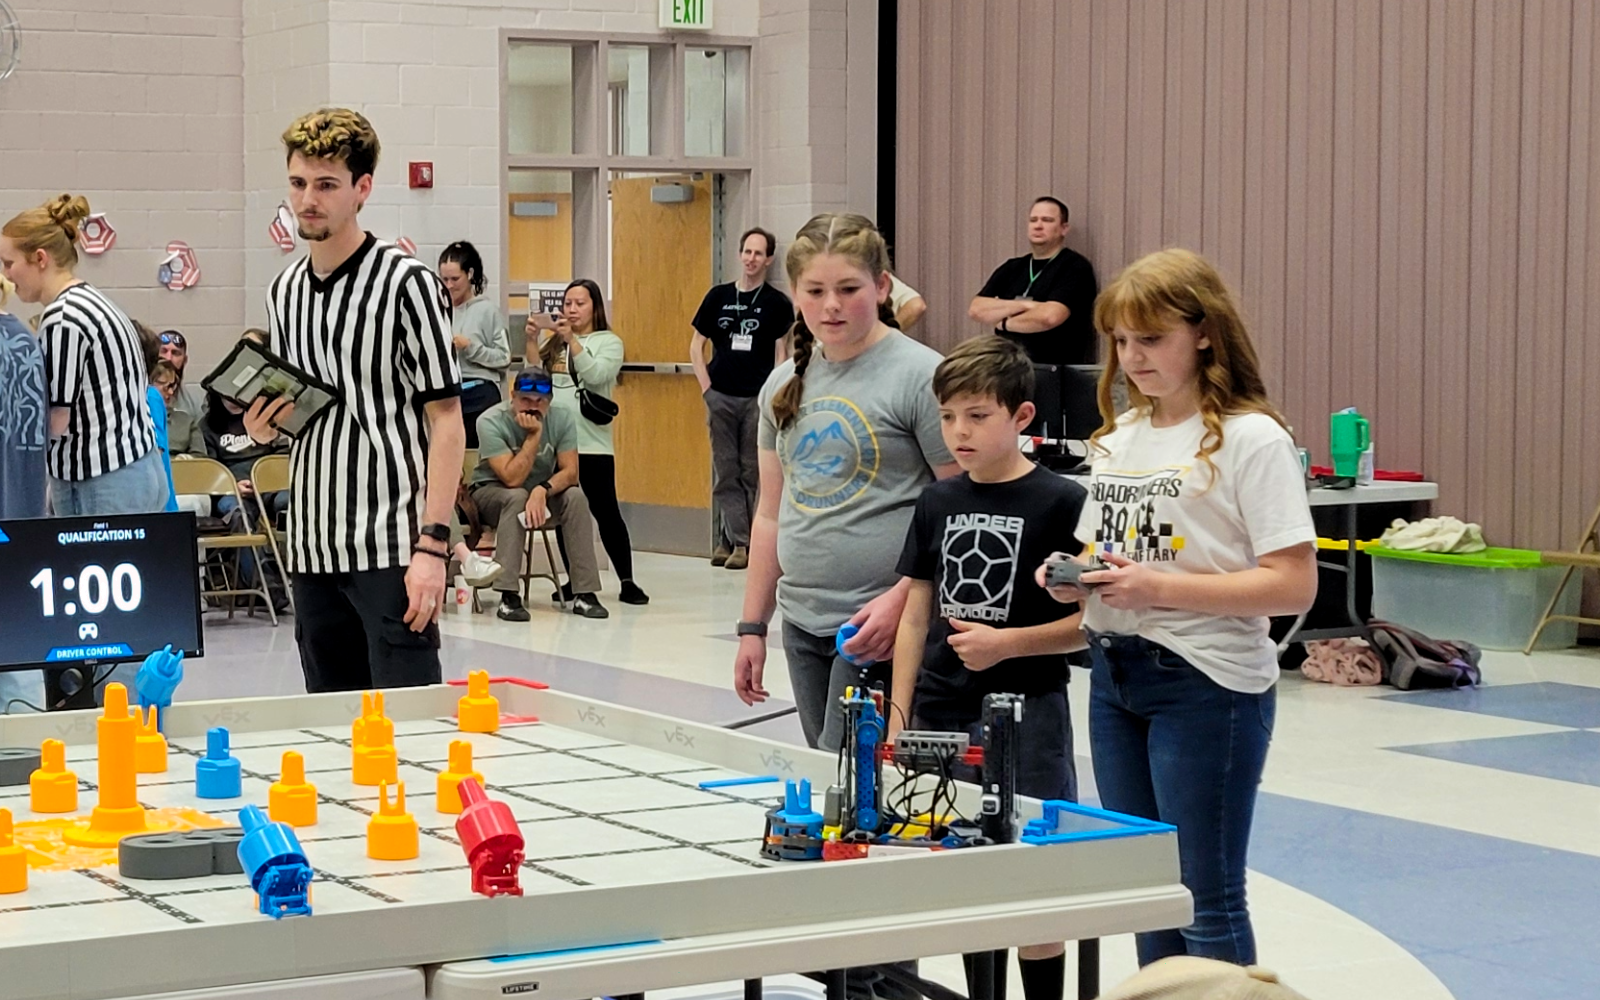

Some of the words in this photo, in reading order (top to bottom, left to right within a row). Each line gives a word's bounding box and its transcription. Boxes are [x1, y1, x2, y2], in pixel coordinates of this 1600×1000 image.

[946, 513, 1025, 533] UNDER
[58, 529, 132, 546] QUALIFICATION
[134, 528, 146, 539] 15
[29, 562, 142, 617] 1:00
[940, 605, 1009, 622] ARMOUR
[56, 648, 85, 659] DRIVER
[86, 646, 123, 657] CONTROL
[203, 706, 252, 725] VEX
[577, 706, 606, 728] VEX
[664, 726, 695, 749] VEX
[760, 749, 795, 773] VEX
